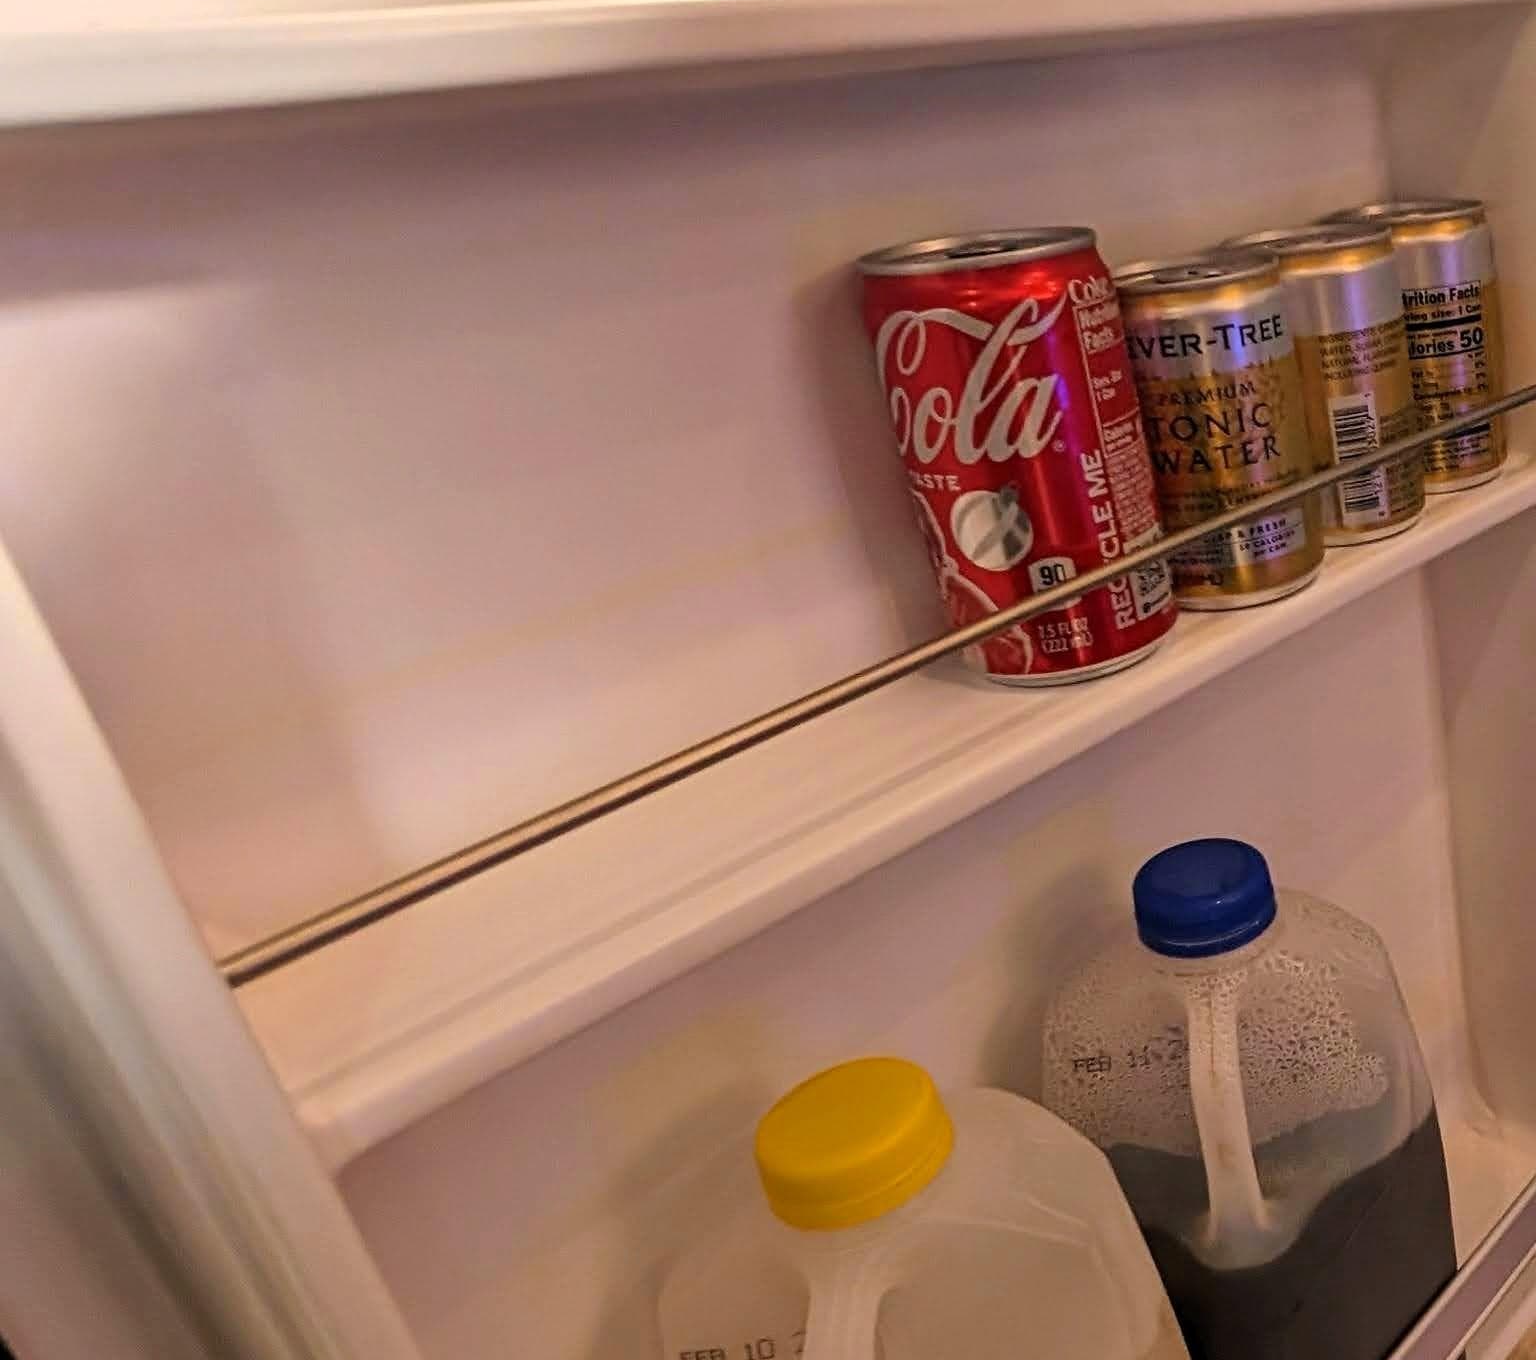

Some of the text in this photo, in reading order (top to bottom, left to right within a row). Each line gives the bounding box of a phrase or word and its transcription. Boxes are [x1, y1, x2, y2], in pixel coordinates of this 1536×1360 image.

[1402, 286, 1481, 309] trition Facts
[1126, 314, 1284, 360] EVER-TREE
[1406, 340, 1455, 358] lories
[1459, 327, 1484, 348] 50
[876, 290, 1068, 465] Cola
[1158, 381, 1257, 406] PREMIUM
[1147, 403, 1273, 442] TONIC
[1081, 449, 1110, 498] ME
[1152, 435, 1281, 475] WATER
[1039, 565, 1068, 586] 90
[1092, 502, 1136, 630] RECCLE
[1072, 1055, 1111, 1072] FEB
